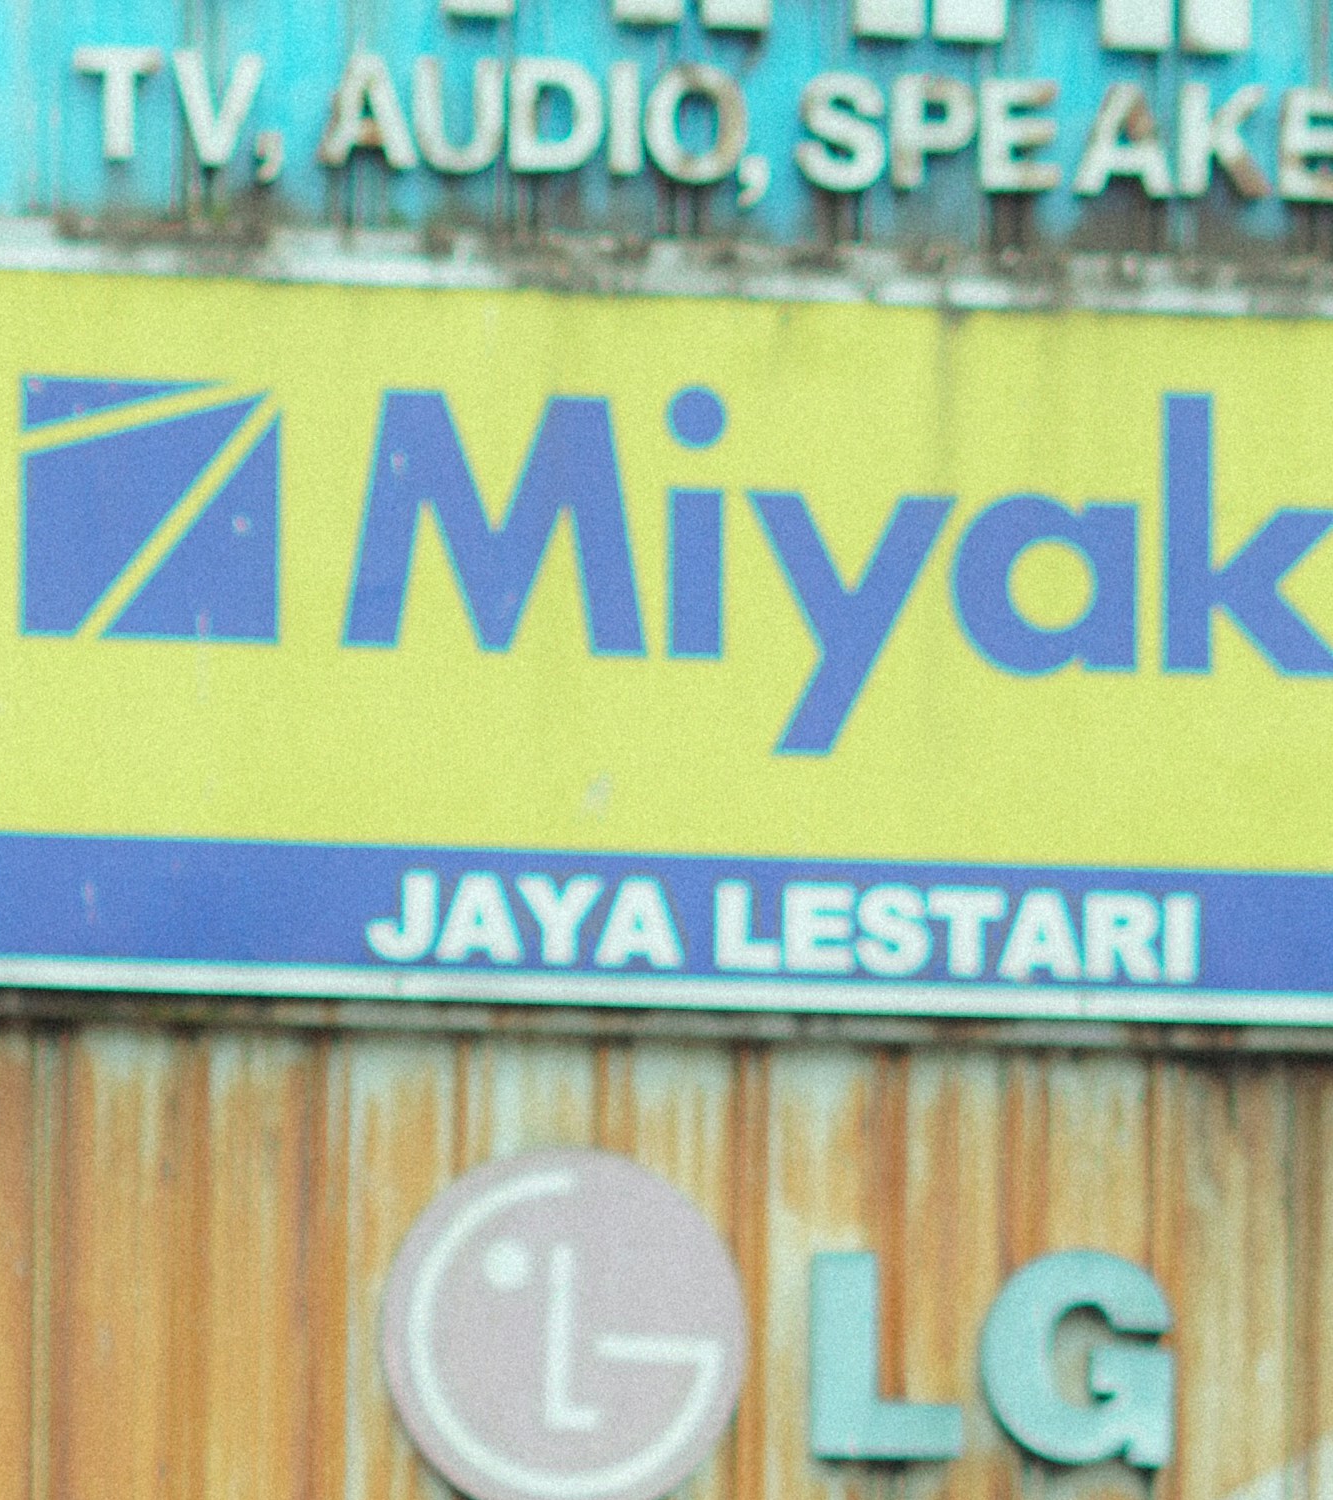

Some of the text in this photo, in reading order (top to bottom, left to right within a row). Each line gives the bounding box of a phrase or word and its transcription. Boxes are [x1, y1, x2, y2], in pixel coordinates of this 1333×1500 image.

[318, 52, 771, 206] AUDIO,
[338, 385, 1333, 757] Miyak
[365, 868, 1201, 985] JAYA LESTARI
[807, 1248, 1177, 1472] LG
